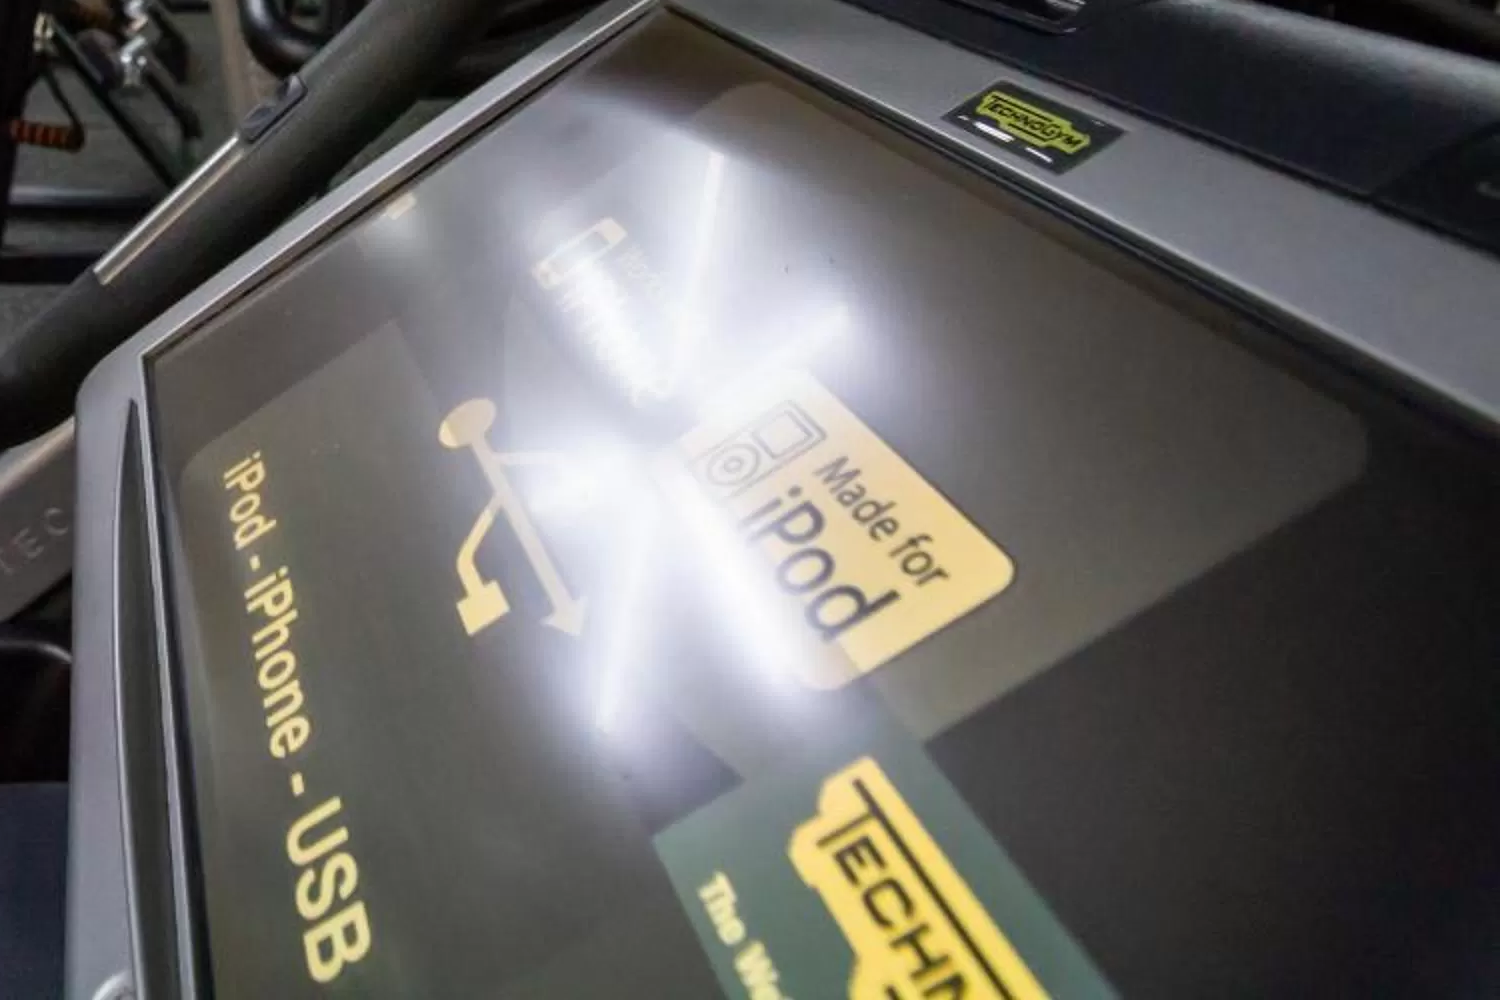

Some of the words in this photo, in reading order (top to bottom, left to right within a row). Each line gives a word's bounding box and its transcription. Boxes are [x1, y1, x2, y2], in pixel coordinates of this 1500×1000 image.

[983, 94, 1083, 147] TECHNOGYM
[224, 451, 277, 550] iPod
[738, 485, 901, 641] iPod
[813, 456, 899, 541] Made
[889, 533, 949, 587] for
[244, 565, 311, 758] iPhone
[286, 796, 371, 983] USB
